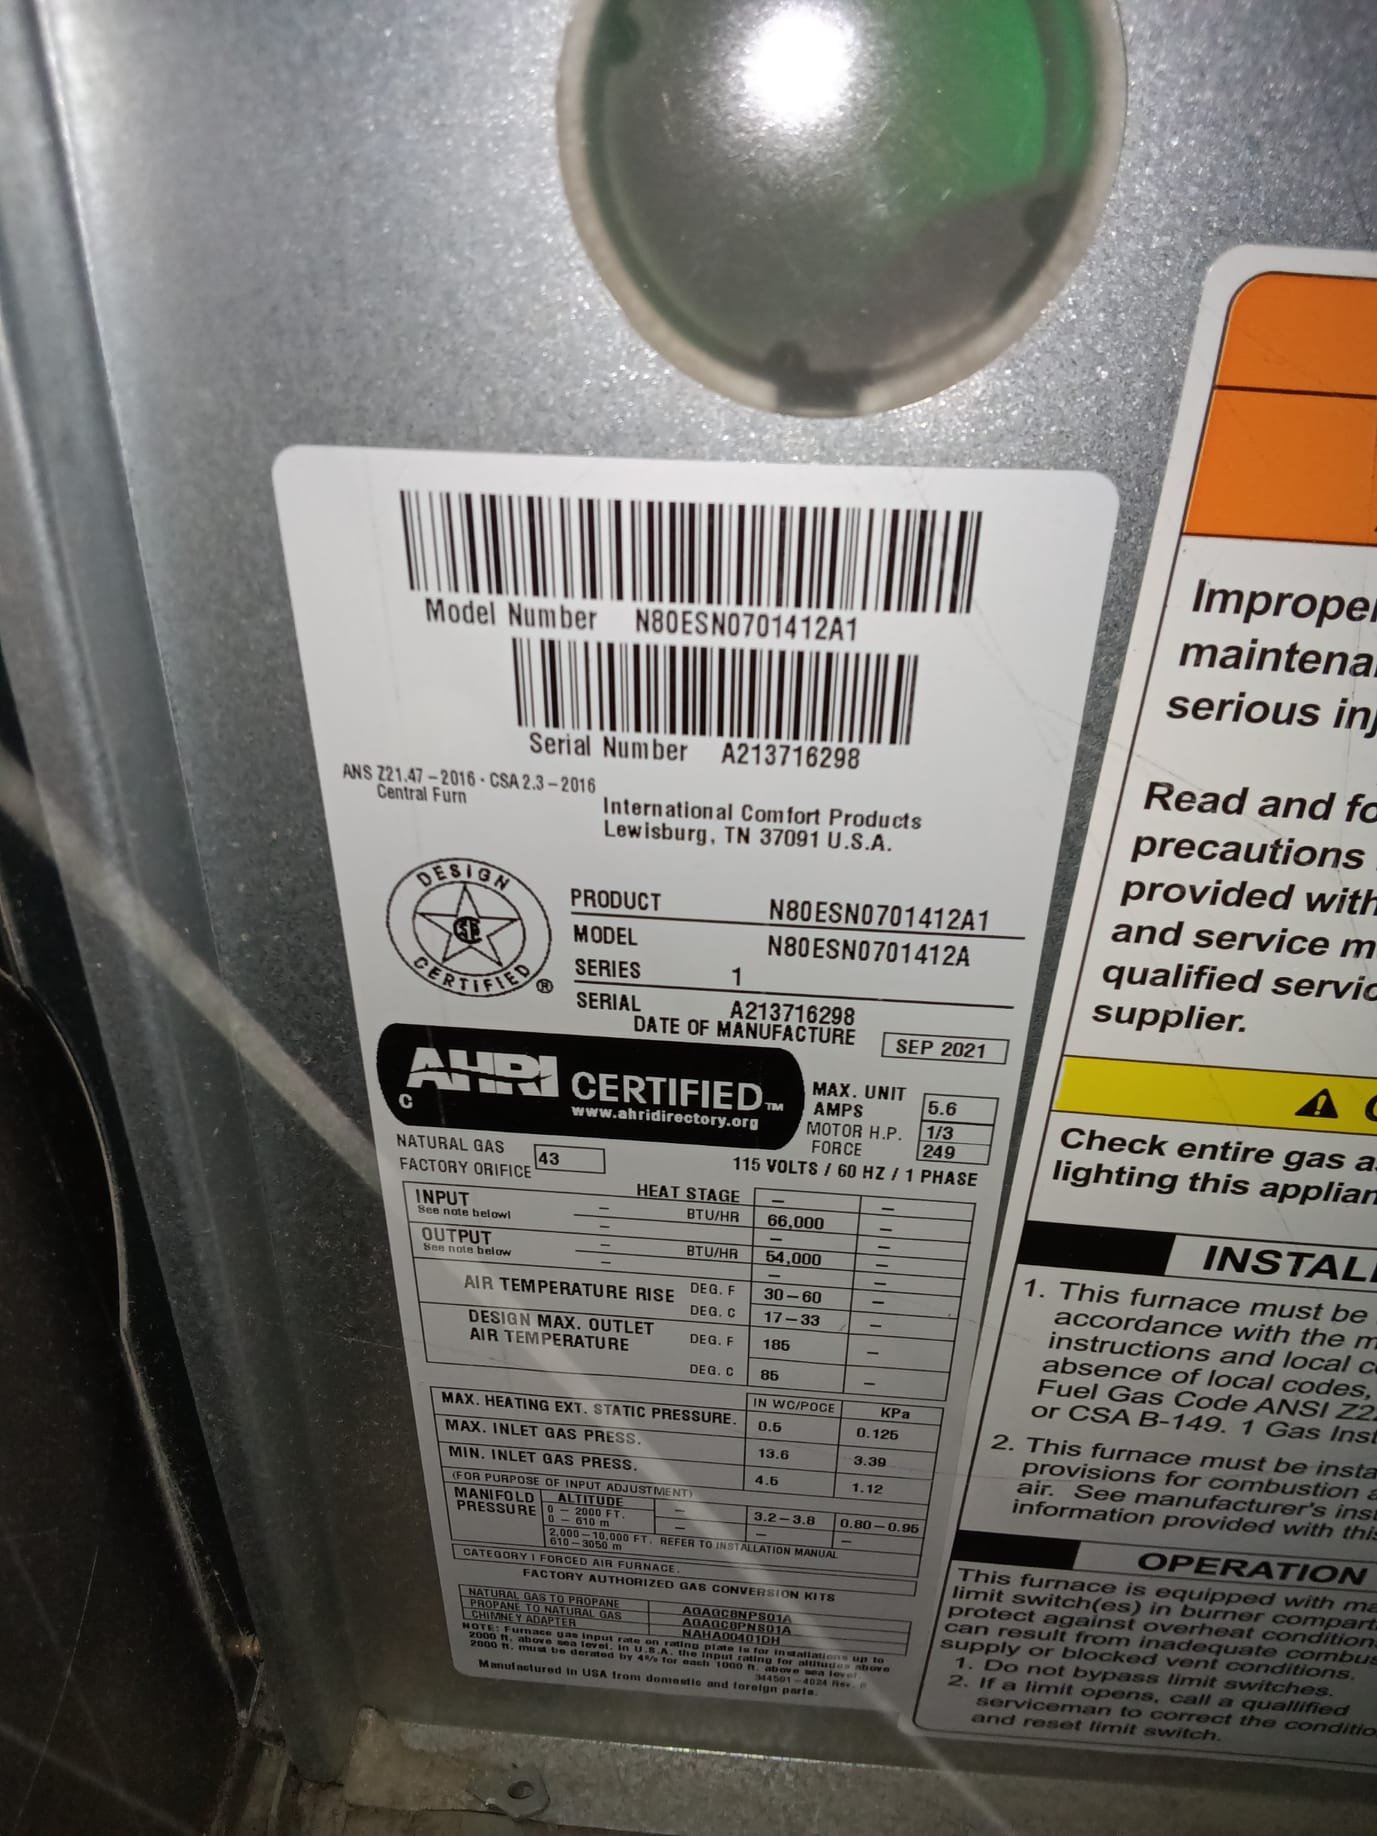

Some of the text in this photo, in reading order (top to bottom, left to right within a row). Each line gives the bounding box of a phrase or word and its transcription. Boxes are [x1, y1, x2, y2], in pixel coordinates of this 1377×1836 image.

[425, 597, 598, 631] Model Number
[636, 608, 857, 642] N80ESN0701412A1
[1178, 641, 1377, 678] maintena
[1166, 691, 1321, 727] serious
[529, 732, 688, 762] Serial Number
[721, 742, 860, 770] A213716298
[377, 783, 467, 804] Central Furn
[1143, 781, 1250, 816] Read
[1257, 792, 1337, 821] and
[603, 796, 923, 830] International Comfort Products
[604, 819, 892, 852] Lewisburg, TN 37091 U.S.A.
[1130, 835, 1366, 872] precautions
[416, 863, 510, 891] DESIGN
[570, 888, 662, 912] PRODUCT
[1119, 879, 1296, 910] provided
[769, 898, 989, 932] N80ESN0701412A1
[573, 924, 639, 946] MODEL
[1111, 920, 1330, 956] and service
[768, 935, 970, 967] N80ESN0701412A
[413, 956, 530, 992] CERTIFIED
[575, 958, 641, 979] SERIES
[731, 966, 741, 987] 1
[1102, 963, 1264, 994] qualified
[576, 991, 641, 1012] SERIAL
[730, 1000, 855, 1026] A213716298
[634, 1015, 856, 1046] DATE OF MANUFACTURE
[1091, 1004, 1246, 1033] supplier.
[896, 1038, 986, 1059] SEP 2021
[406, 1046, 559, 1098] AHRI
[571, 1071, 763, 1112] CERTIFIED
[813, 1081, 908, 1102] MAX. UNIT
[571, 1105, 759, 1131] www.ahridirectory.org
[813, 1101, 864, 1118] AMPS
[928, 1100, 958, 1116] 5.6
[396, 1133, 505, 1154] NATURAL GAS
[806, 1121, 902, 1141] MOTOR H.P.
[927, 1125, 954, 1140] 1/3
[538, 1151, 560, 1166] 43
[811, 1139, 862, 1157] FORCE
[922, 1144, 956, 1160] 249
[1060, 1127, 1346, 1172] Check entire gas
[399, 1157, 532, 1179] FACTORY ORIFICE
[733, 1157, 978, 1187] 115 VOLTS 60 HZ 1 PHASE
[1052, 1159, 1179, 1195] lighting
[1189, 1172, 1250, 1195] this
[415, 1188, 470, 1207] INPUT
[636, 1183, 741, 1203] HEAT STAGE
[687, 1208, 739, 1223] BTU/HR
[767, 1214, 824, 1230] 66,000
[421, 1227, 492, 1245] OUTPUT
[766, 1250, 822, 1266] 54,000
[464, 1274, 675, 1303] AIR TEMPERATURE RISE
[1024, 1278, 1368, 1324] 1. This furnace must be
[468, 1309, 655, 1335] DESIGN MAX. OUTLET
[1054, 1311, 1346, 1347] accordance with the
[763, 1338, 791, 1352] 185
[760, 1369, 779, 1381] 85
[441, 1391, 736, 1425] MAX. HEATING EXT. STATIC PRESSURE.
[880, 1407, 910, 1420] KPa
[445, 1418, 641, 1445] MAX. INLET GAS PRESS.
[758, 1420, 782, 1433] 0.5
[856, 1427, 899, 1441] 0.125
[1031, 1405, 1061, 1419] or
[1068, 1405, 1130, 1426] CSA
[1138, 1411, 1226, 1434] B-149.
[1242, 1419, 1254, 1436] 1
[1265, 1421, 1321, 1440] Gas
[758, 1448, 789, 1460] 13.6
[853, 1455, 887, 1468] 3.39
[990, 1434, 1014, 1451] 2.
[1026, 1436, 1082, 1457] This
[1091, 1442, 1192, 1466] furnace
[1199, 1455, 1267, 1472] must
[1273, 1457, 1309, 1475] be
[454, 1486, 534, 1503] MANIFOLD
[456, 1499, 536, 1516] PRESSURE
[557, 1492, 624, 1507] ALTITUDE
[1138, 1552, 1368, 1585] OPERATION
[523, 1568, 835, 1602] FACTORY AUTHORIZED GAS CONVERSION KITS
[471, 1610, 577, 1627] CHIMNEY ADAPTER
[940, 1639, 1355, 1681] supply or blocked vent conditions.
[955, 1656, 1333, 1697] 1. Do not bypass limit switches.
